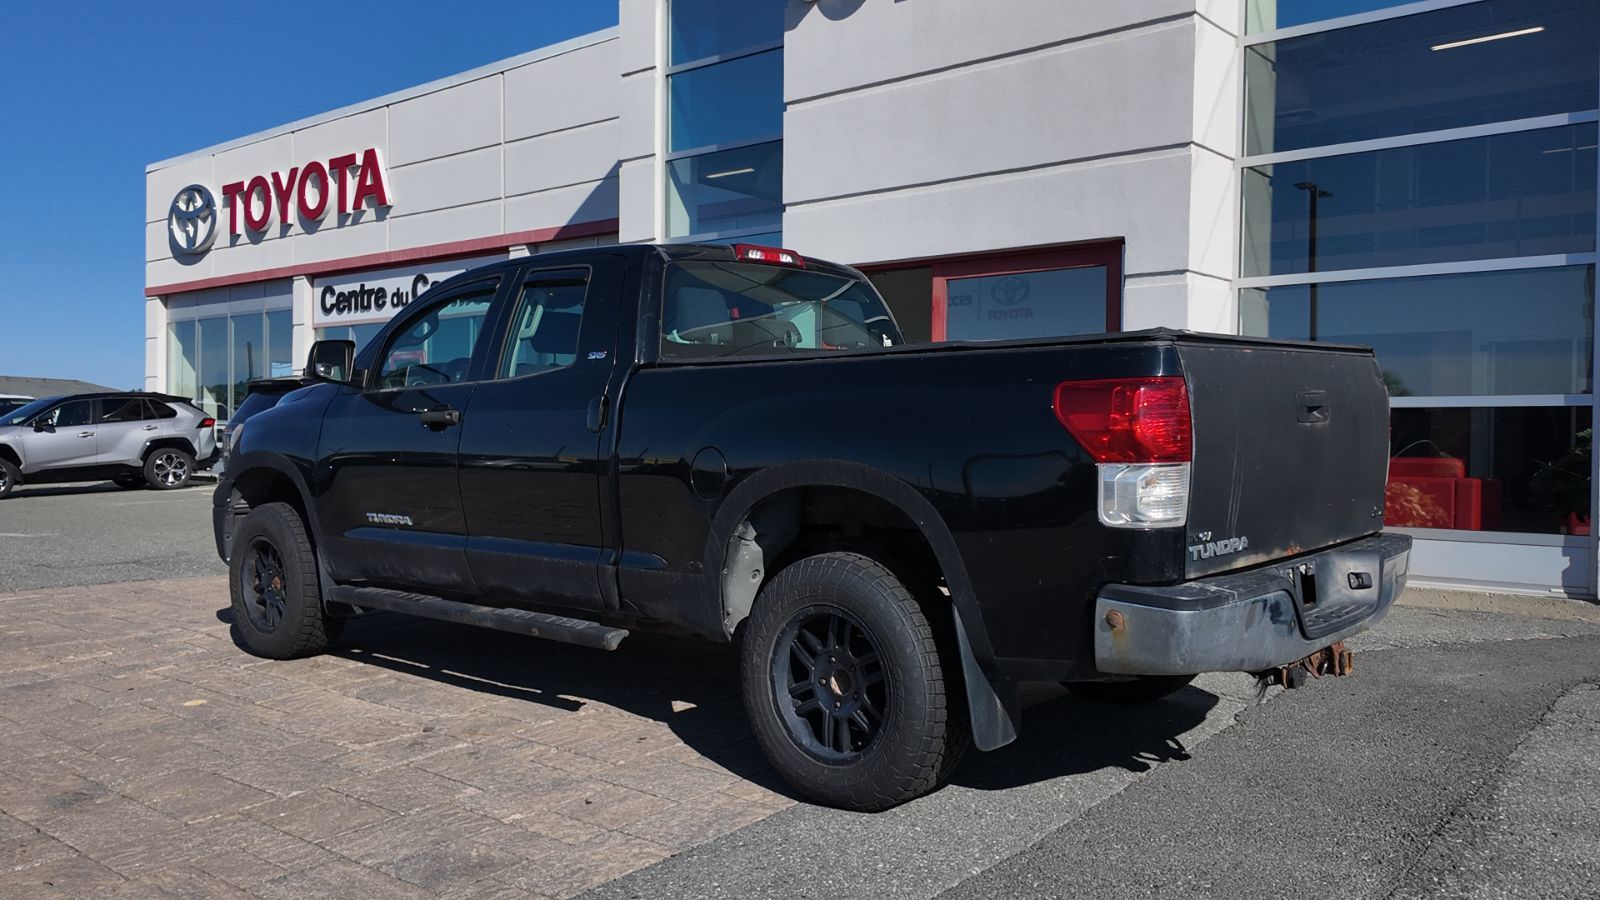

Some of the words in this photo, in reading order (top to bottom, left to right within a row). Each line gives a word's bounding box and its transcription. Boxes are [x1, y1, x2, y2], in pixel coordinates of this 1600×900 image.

[222, 148, 390, 235] TOYOTA
[320, 283, 387, 316] Centre
[391, 287, 409, 308] du
[412, 273, 441, 301] C
[986, 308, 1034, 320] TOYOTA
[366, 512, 413, 526] TUNDRA
[1188, 536, 1249, 561] TUNDRA
